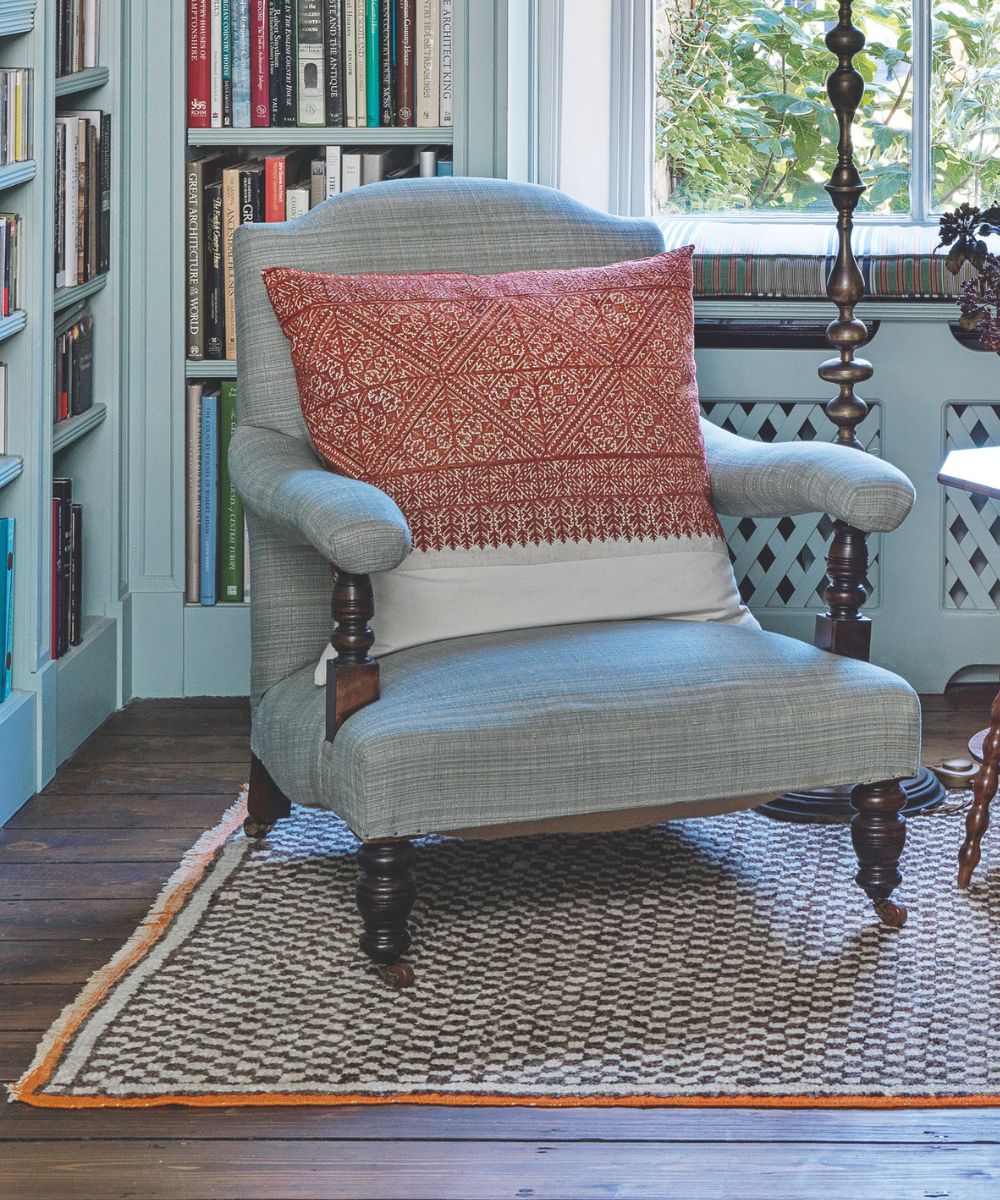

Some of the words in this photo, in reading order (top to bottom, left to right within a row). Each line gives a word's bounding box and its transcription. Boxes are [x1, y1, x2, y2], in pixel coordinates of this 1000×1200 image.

[274, 9, 282, 33] Robert
[272, 35, 282, 67] Smythson
[443, 10, 452, 67] ARCHITECT
[331, 57, 339, 97] ANTIQUE
[443, 72, 451, 99] KING
[189, 173, 198, 205] GREAT
[190, 208, 199, 283] ARCHITECTURE
[190, 298, 199, 334] WORLD
